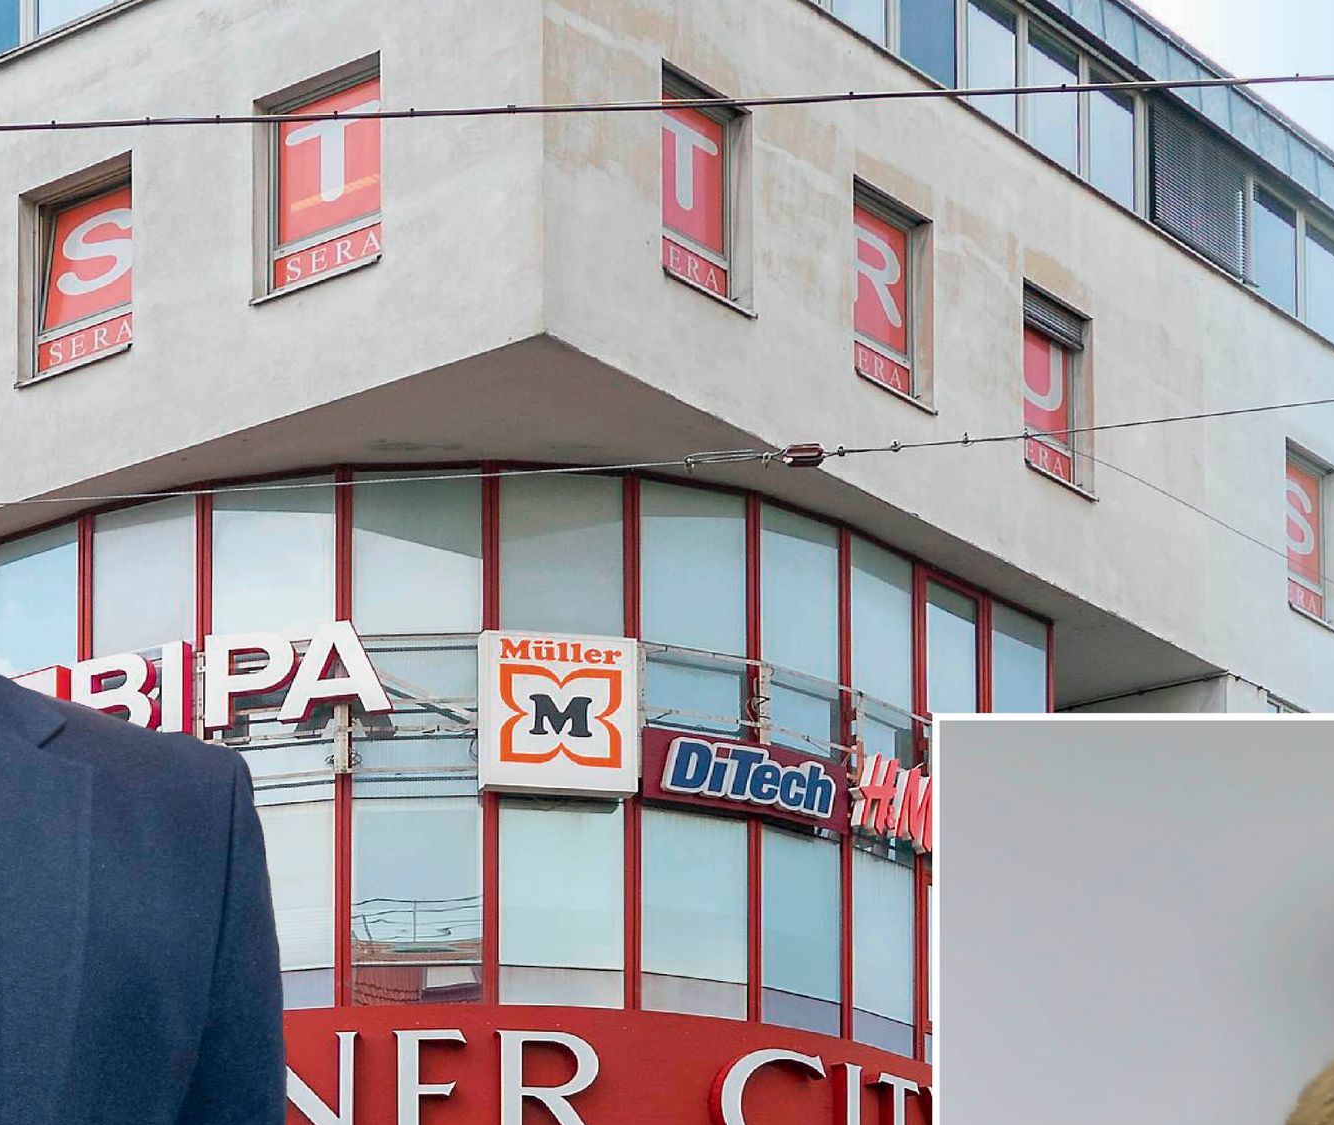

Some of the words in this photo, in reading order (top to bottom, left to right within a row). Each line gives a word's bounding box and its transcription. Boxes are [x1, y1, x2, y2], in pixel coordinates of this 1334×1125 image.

[285, 100, 380, 202] T
[663, 113, 718, 212] T
[57, 208, 132, 296] S
[286, 230, 381, 282] SERA
[853, 224, 902, 328] R
[49, 319, 133, 366] SERA
[500, 638, 622, 665] Müller
[529, 694, 593, 738] M
[669, 740, 835, 814] DiTech
